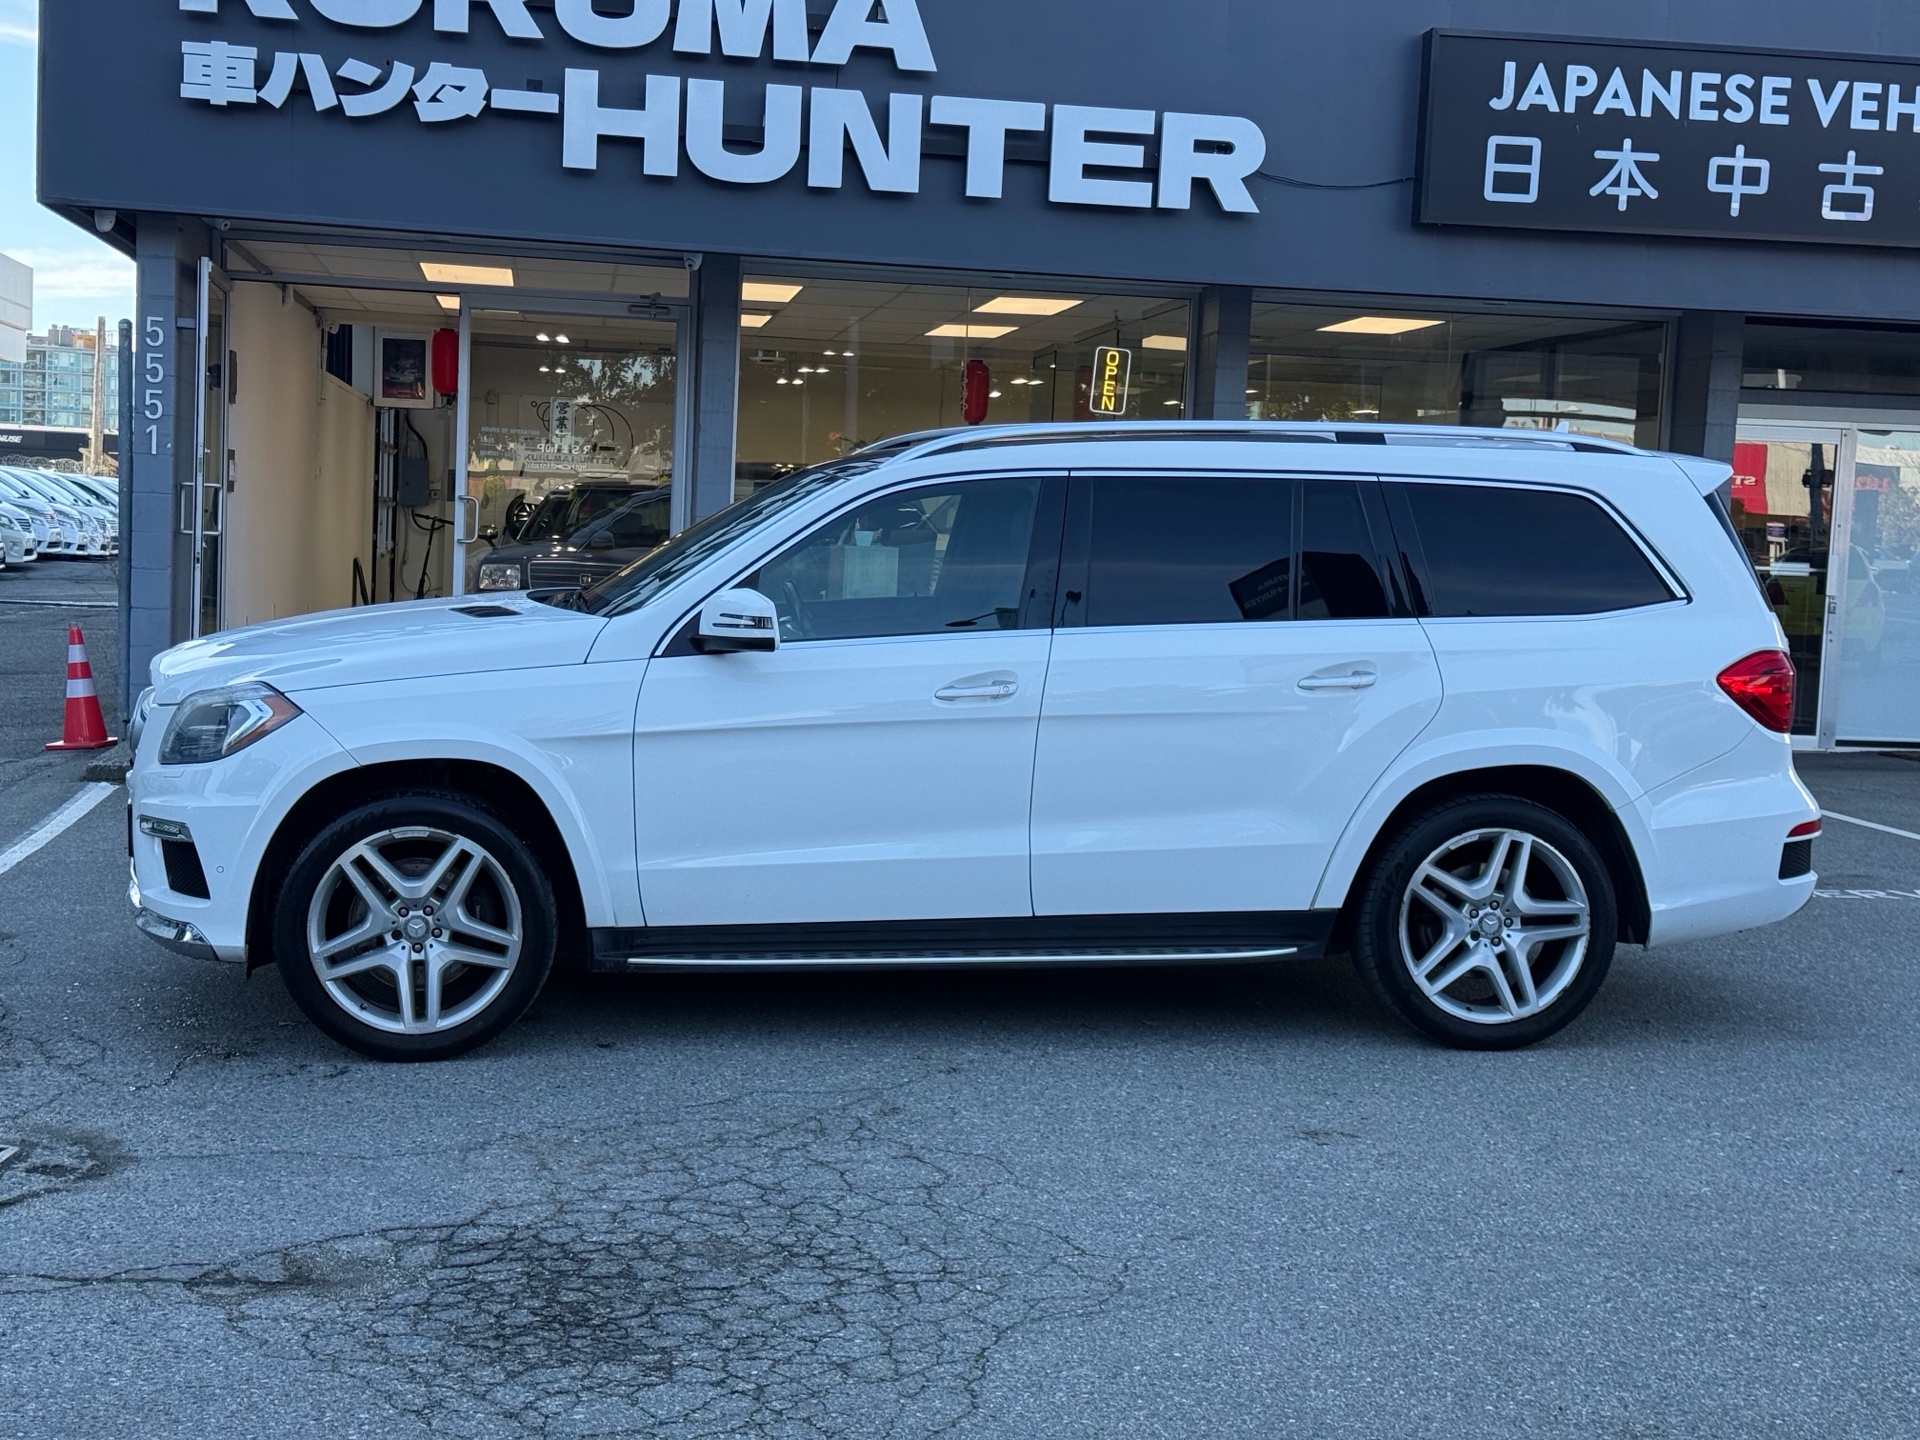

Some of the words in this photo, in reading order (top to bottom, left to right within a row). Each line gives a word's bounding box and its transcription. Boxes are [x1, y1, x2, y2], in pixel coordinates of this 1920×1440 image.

[178, 0, 937, 72] UMA
[180, 40, 560, 122] 車ハンター
[563, 68, 1267, 213] HUNTER
[1489, 61, 1792, 126] JAPANESE
[145, 316, 164, 455] 5551
[1101, 350, 1119, 411] OPEN
